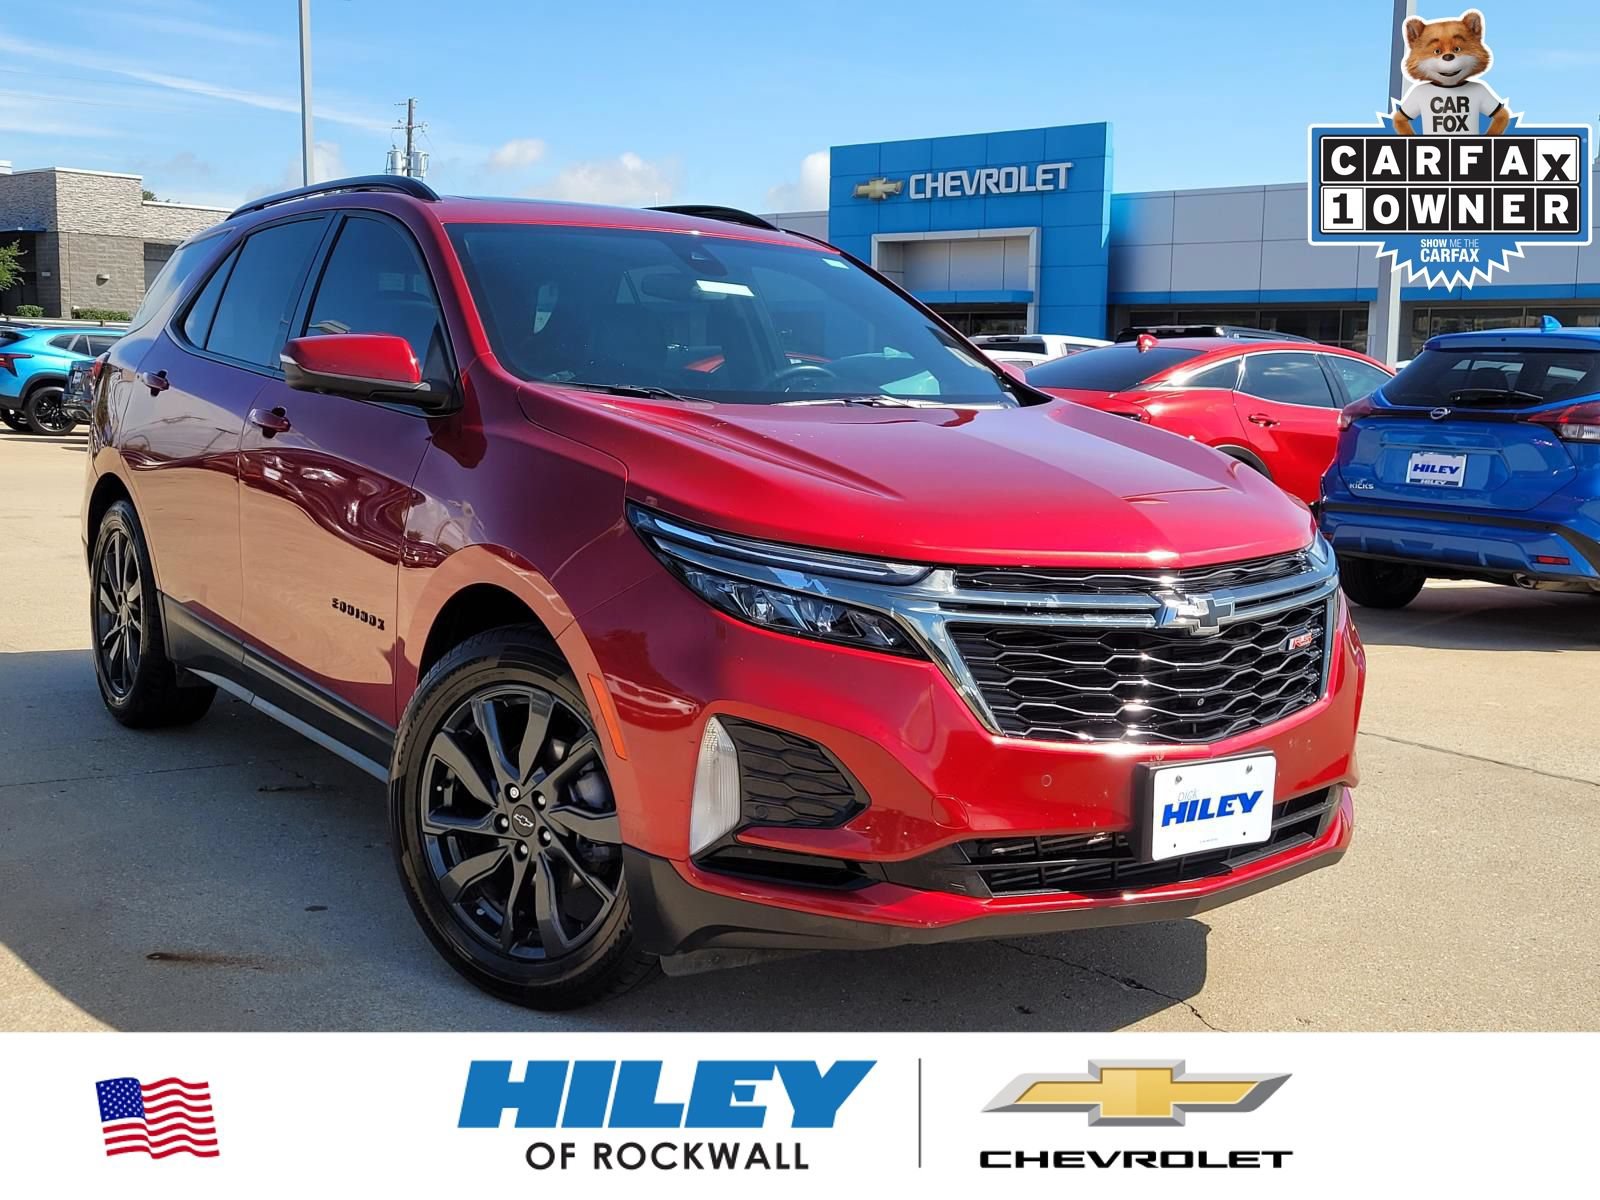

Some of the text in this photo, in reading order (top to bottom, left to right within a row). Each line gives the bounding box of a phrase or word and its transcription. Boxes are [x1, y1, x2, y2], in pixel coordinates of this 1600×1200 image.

[909, 161, 1073, 200] CHEVROLET
[1412, 463, 1460, 475] HILEY
[1161, 790, 1264, 828] HILEY
